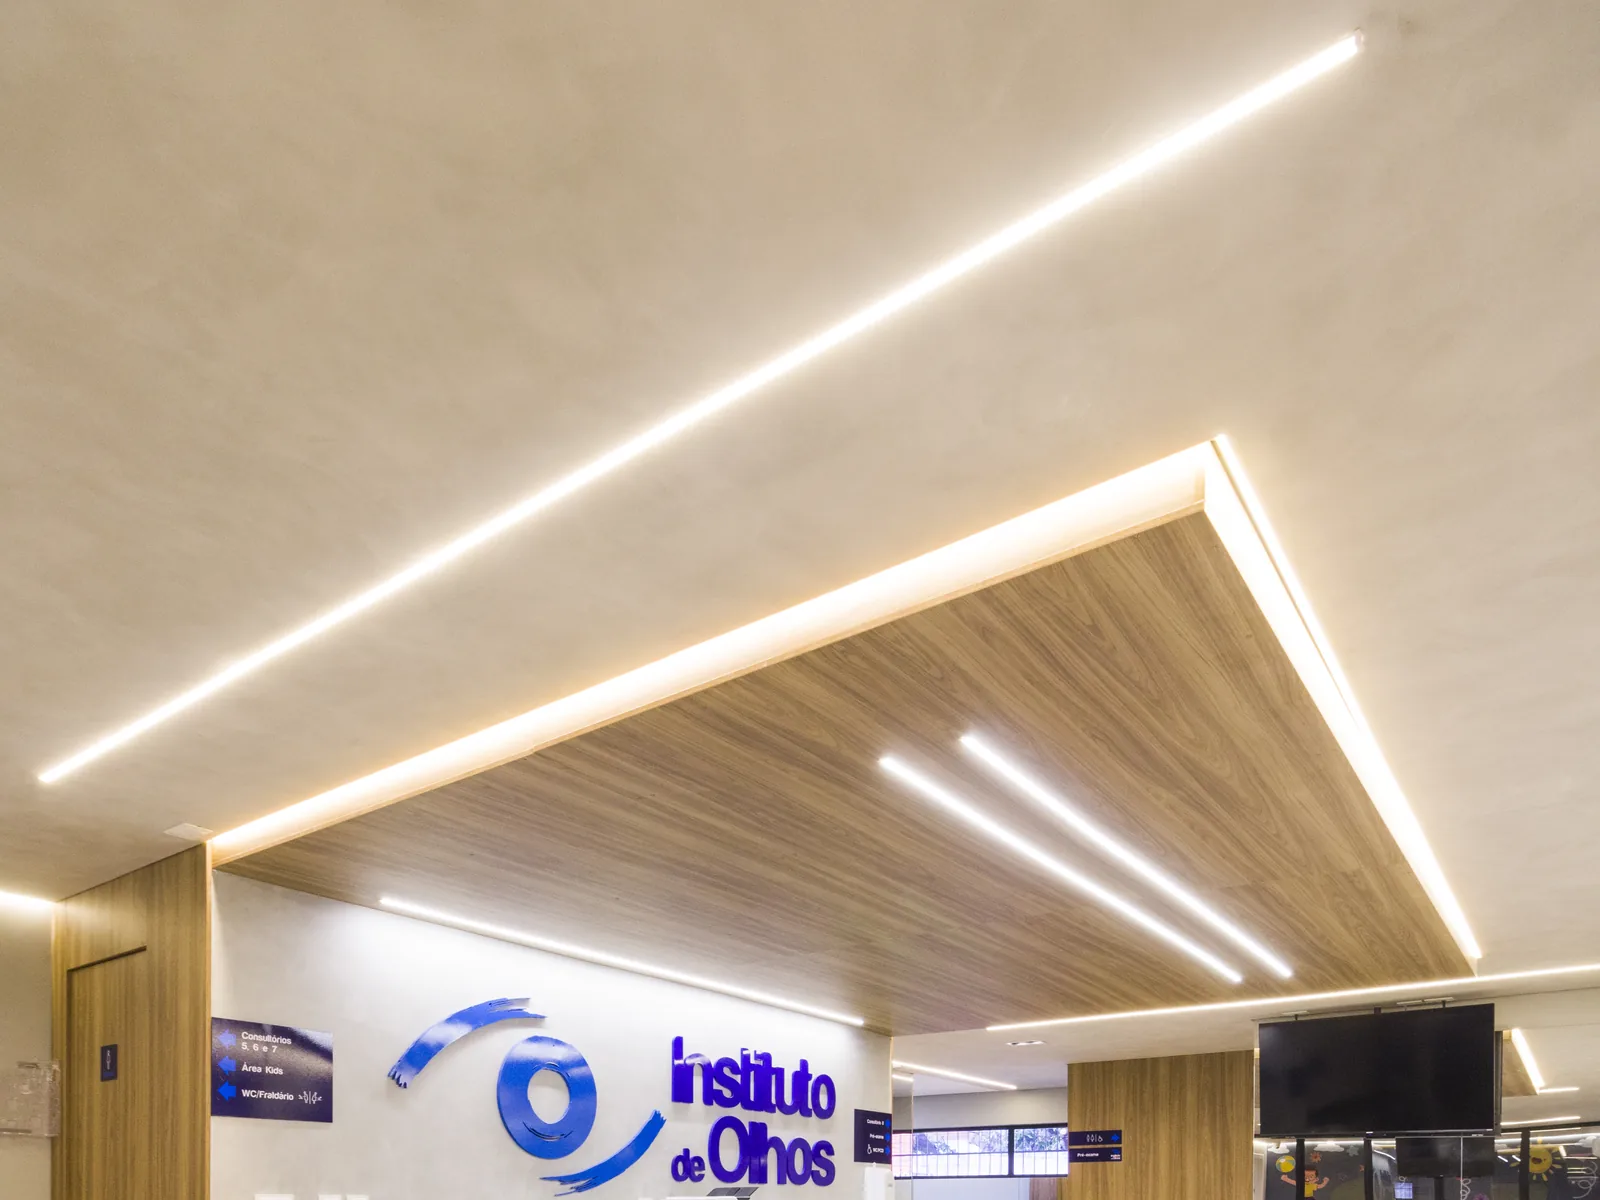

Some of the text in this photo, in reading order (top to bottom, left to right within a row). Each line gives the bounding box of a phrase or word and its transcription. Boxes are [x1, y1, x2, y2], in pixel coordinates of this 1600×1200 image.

[241, 1031, 292, 1045] Consultórios
[252, 1043, 259, 1051] 6
[271, 1045, 278, 1053] 7
[241, 1062, 284, 1075] Área Kids
[671, 1036, 836, 1120] Instituto
[241, 1088, 294, 1101] WC/Fraldário
[671, 1115, 836, 1187] de Olhos
